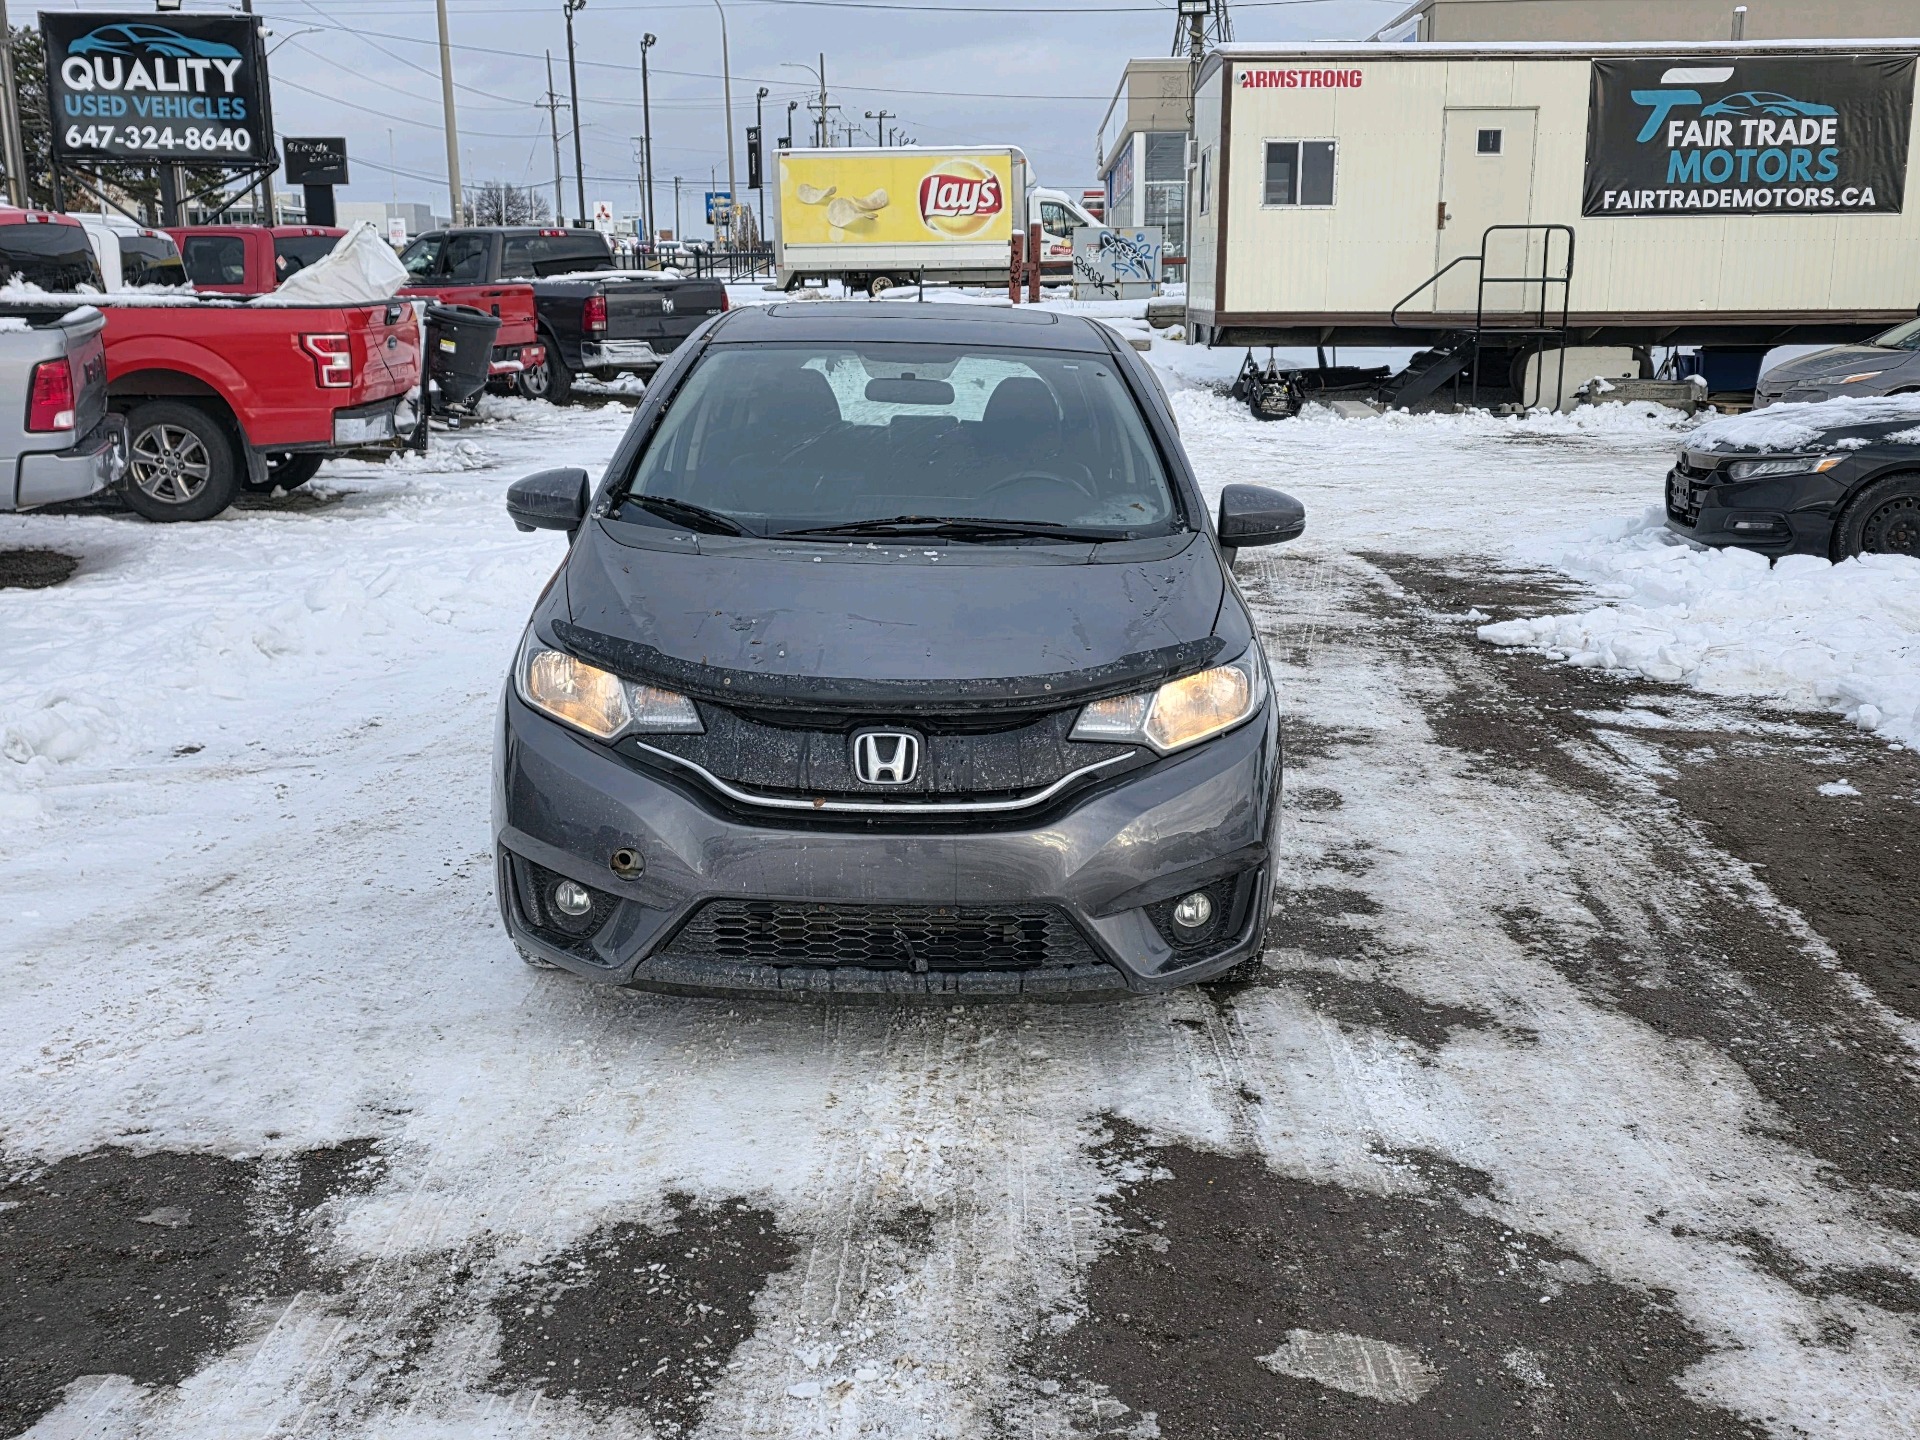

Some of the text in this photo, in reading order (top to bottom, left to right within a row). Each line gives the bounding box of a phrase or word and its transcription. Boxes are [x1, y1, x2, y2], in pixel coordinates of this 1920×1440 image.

[61, 57, 242, 92] QUALITY
[1242, 69, 1363, 89] ARMSTRONG
[64, 95, 247, 120] USED VEHICLES
[65, 124, 251, 152] 647-324-8640
[1667, 118, 1838, 147] FAIR TRADE
[1666, 147, 1839, 184] MOTORS
[924, 176, 997, 217] Lay's
[1603, 186, 1876, 210] FAIRTRADEMOTORS.CA
